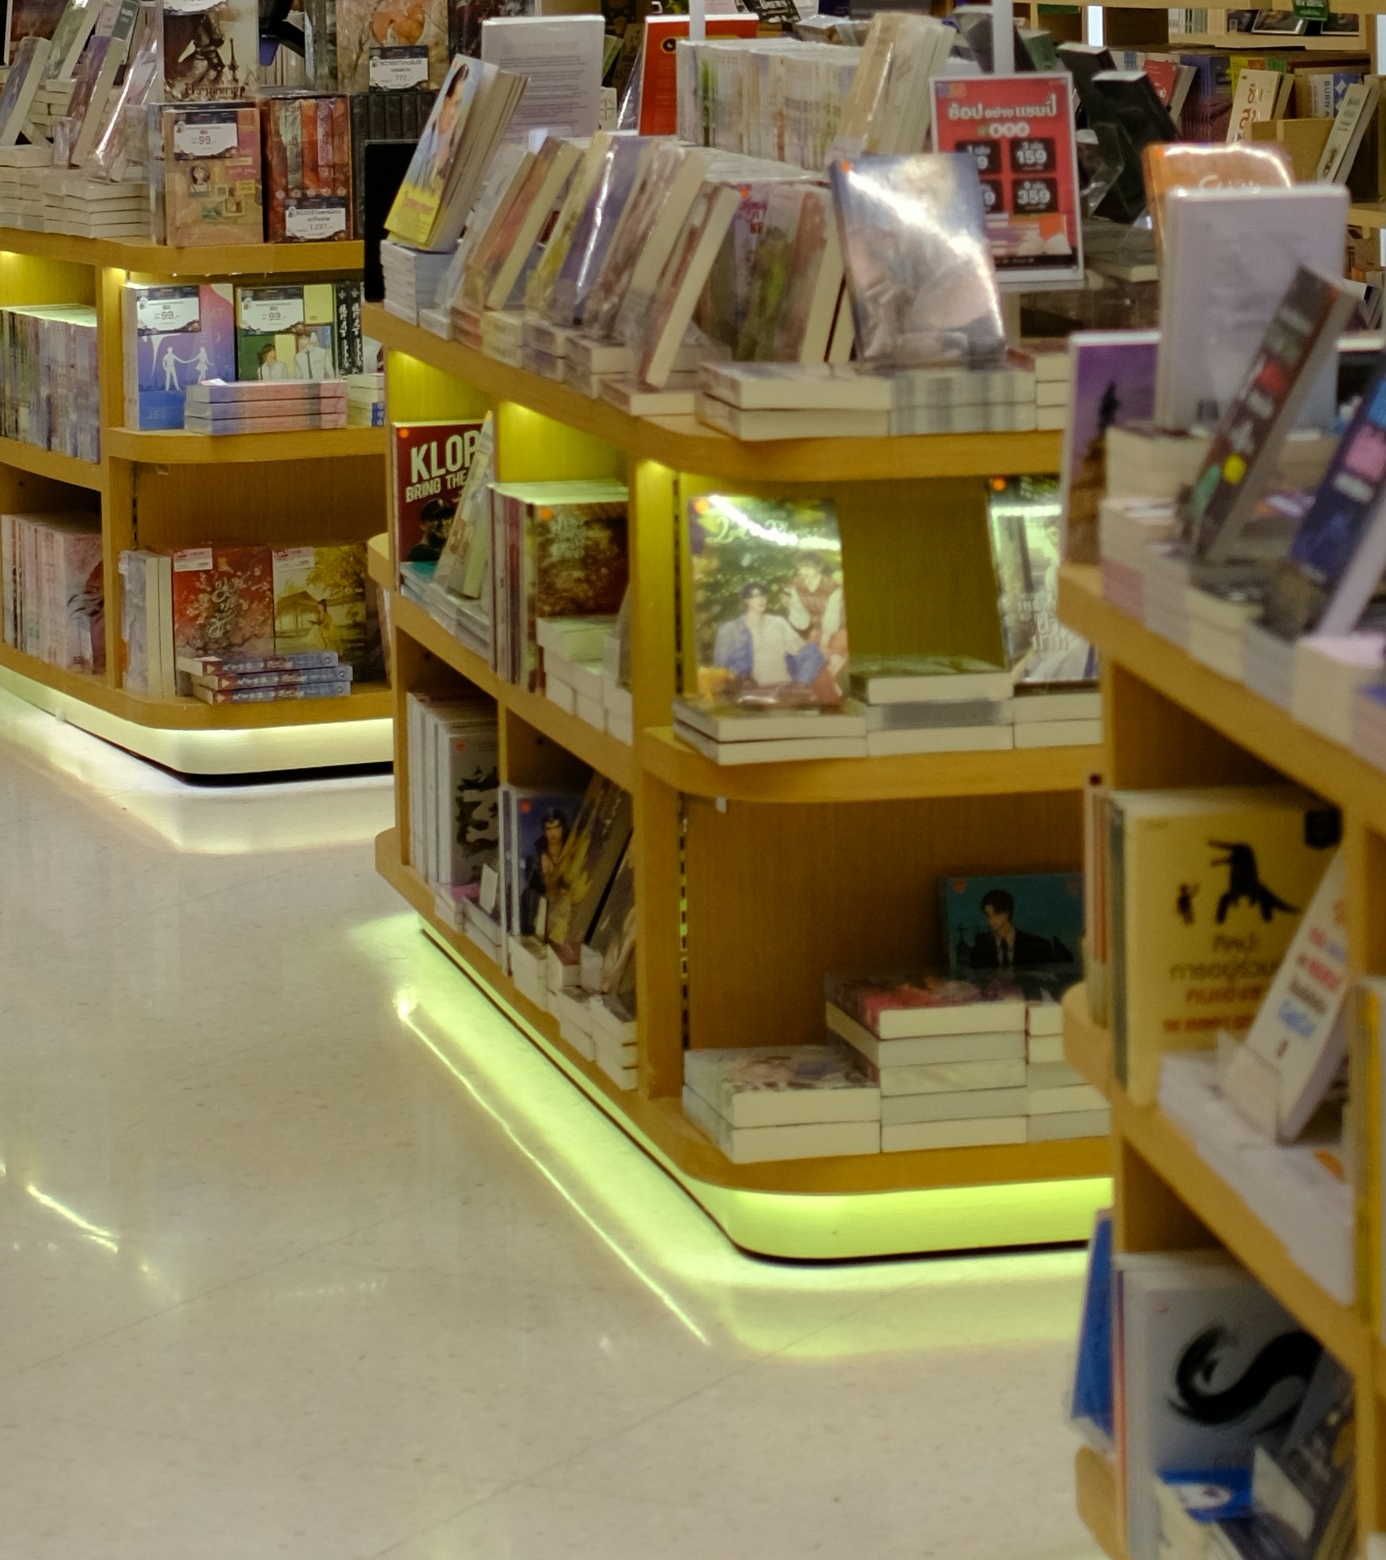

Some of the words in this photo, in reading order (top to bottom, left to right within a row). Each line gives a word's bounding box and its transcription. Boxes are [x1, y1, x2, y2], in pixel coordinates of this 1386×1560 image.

[1016, 149, 1048, 166] 159
[1016, 189, 1052, 205] 359
[410, 429, 481, 484] KLOP
[405, 477, 442, 503] BRING
